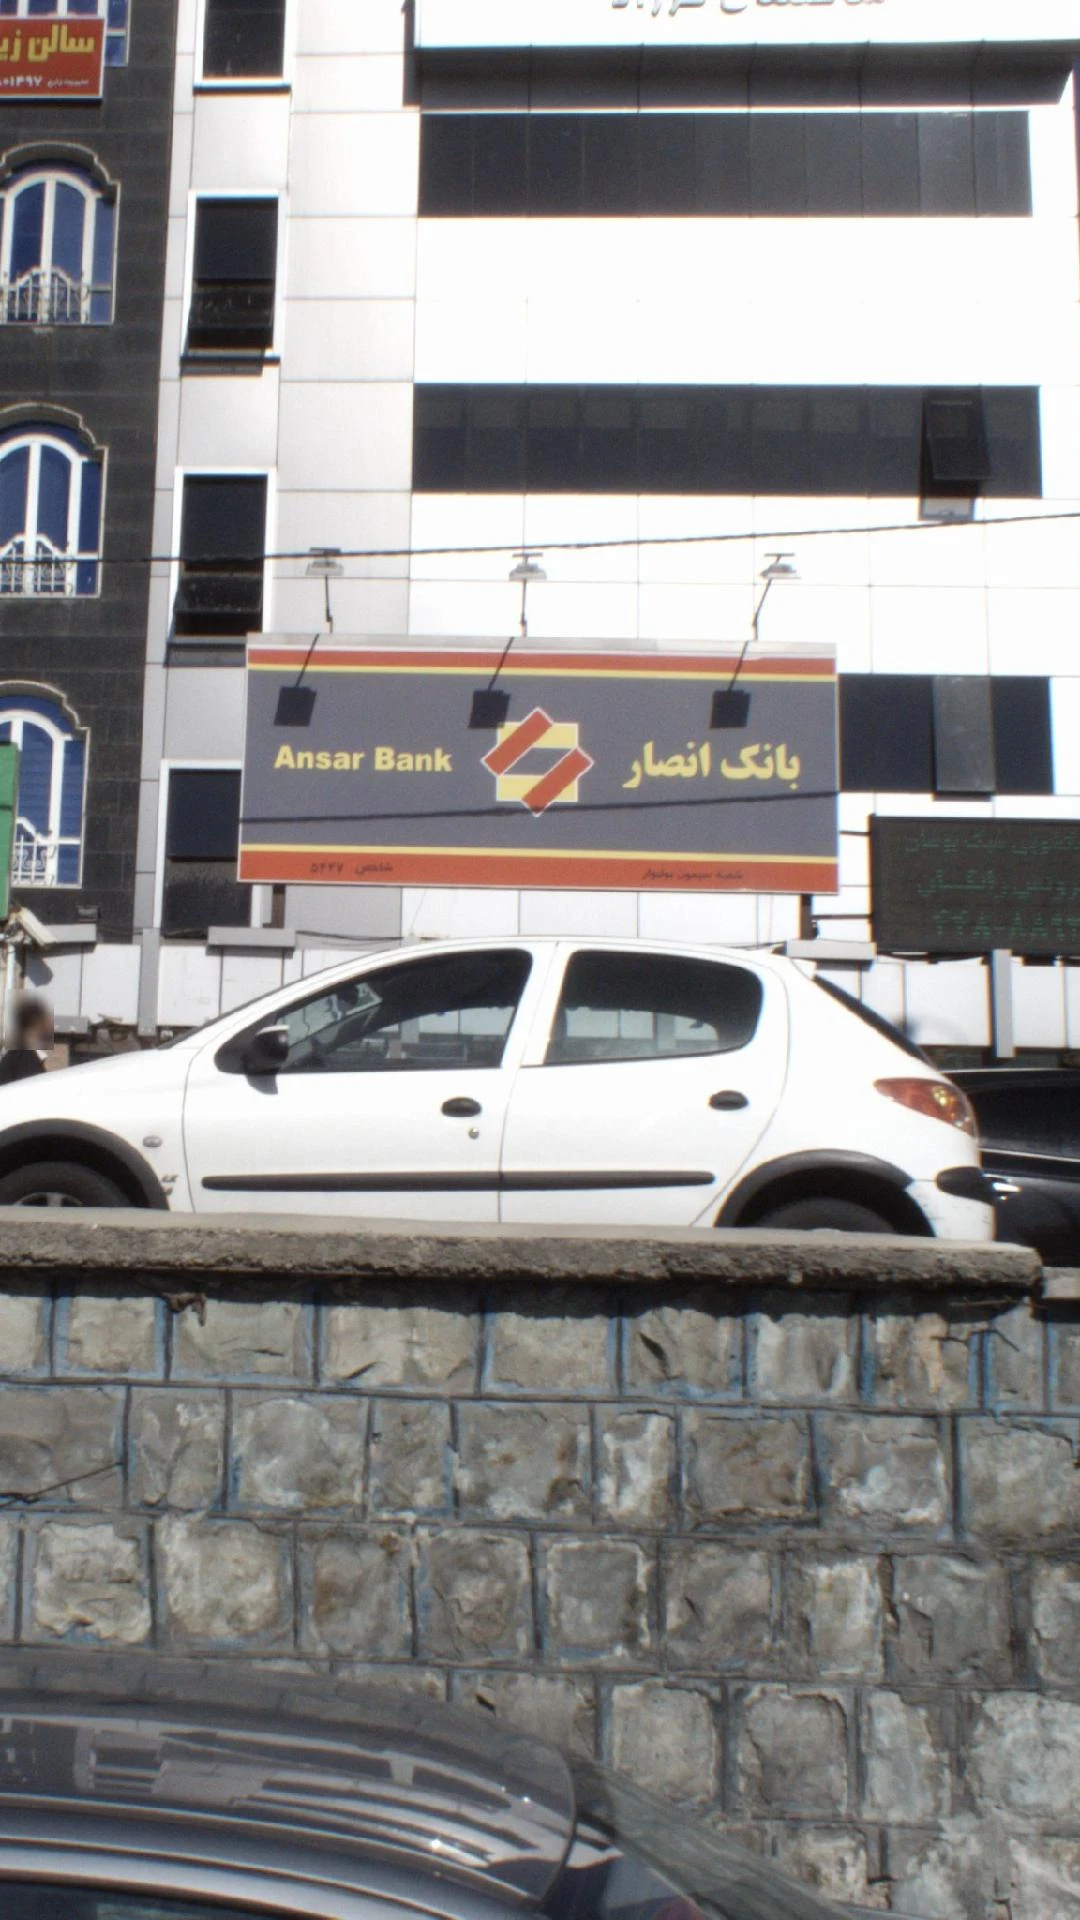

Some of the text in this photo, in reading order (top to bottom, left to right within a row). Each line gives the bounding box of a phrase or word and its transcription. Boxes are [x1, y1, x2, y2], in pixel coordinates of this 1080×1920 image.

[28, 23, 95, 62] سالن
[274, 744, 452, 772] Ansar Bank
[622, 740, 800, 790] بانک انصار
